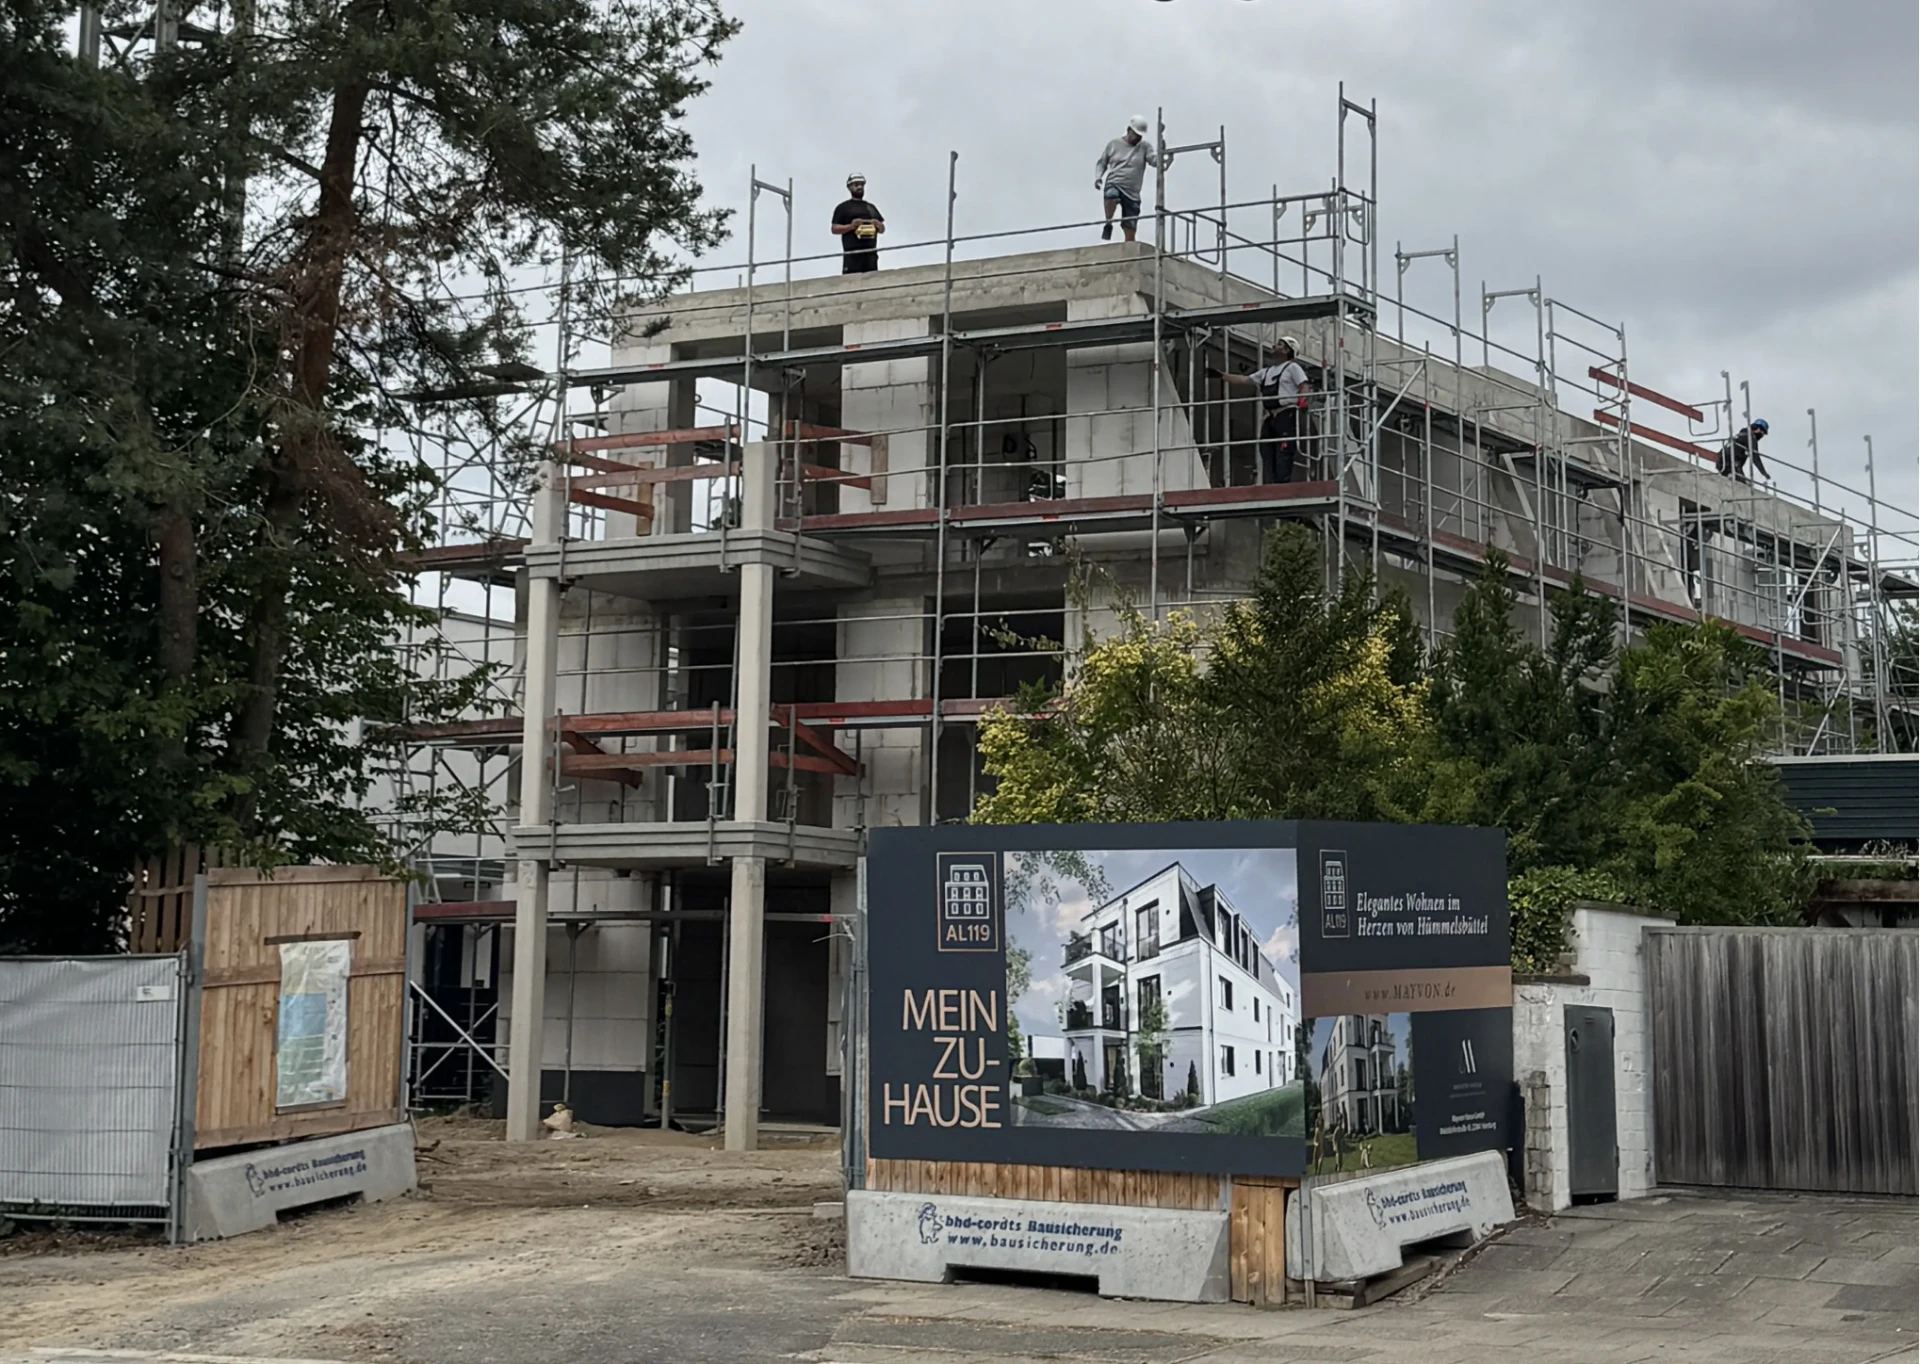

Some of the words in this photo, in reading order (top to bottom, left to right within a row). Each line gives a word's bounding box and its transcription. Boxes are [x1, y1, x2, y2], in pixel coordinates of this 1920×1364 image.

[1356, 892, 1404, 918] Elegantes
[1405, 892, 1445, 912] Wohnen
[1447, 893, 1461, 911] im
[945, 924, 991, 942] AL119
[1357, 917, 1394, 937] Herzen
[1396, 921, 1414, 936] von
[902, 988, 998, 1032] MEIN
[932, 1036, 1001, 1081] ZU-
[883, 1082, 1002, 1129] HAUSE
[944, 1215, 1022, 1232] bhd-cordts
[1027, 1220, 1123, 1241] Bausicherung
[947, 1233, 1119, 1257] www.bausicherung.de
